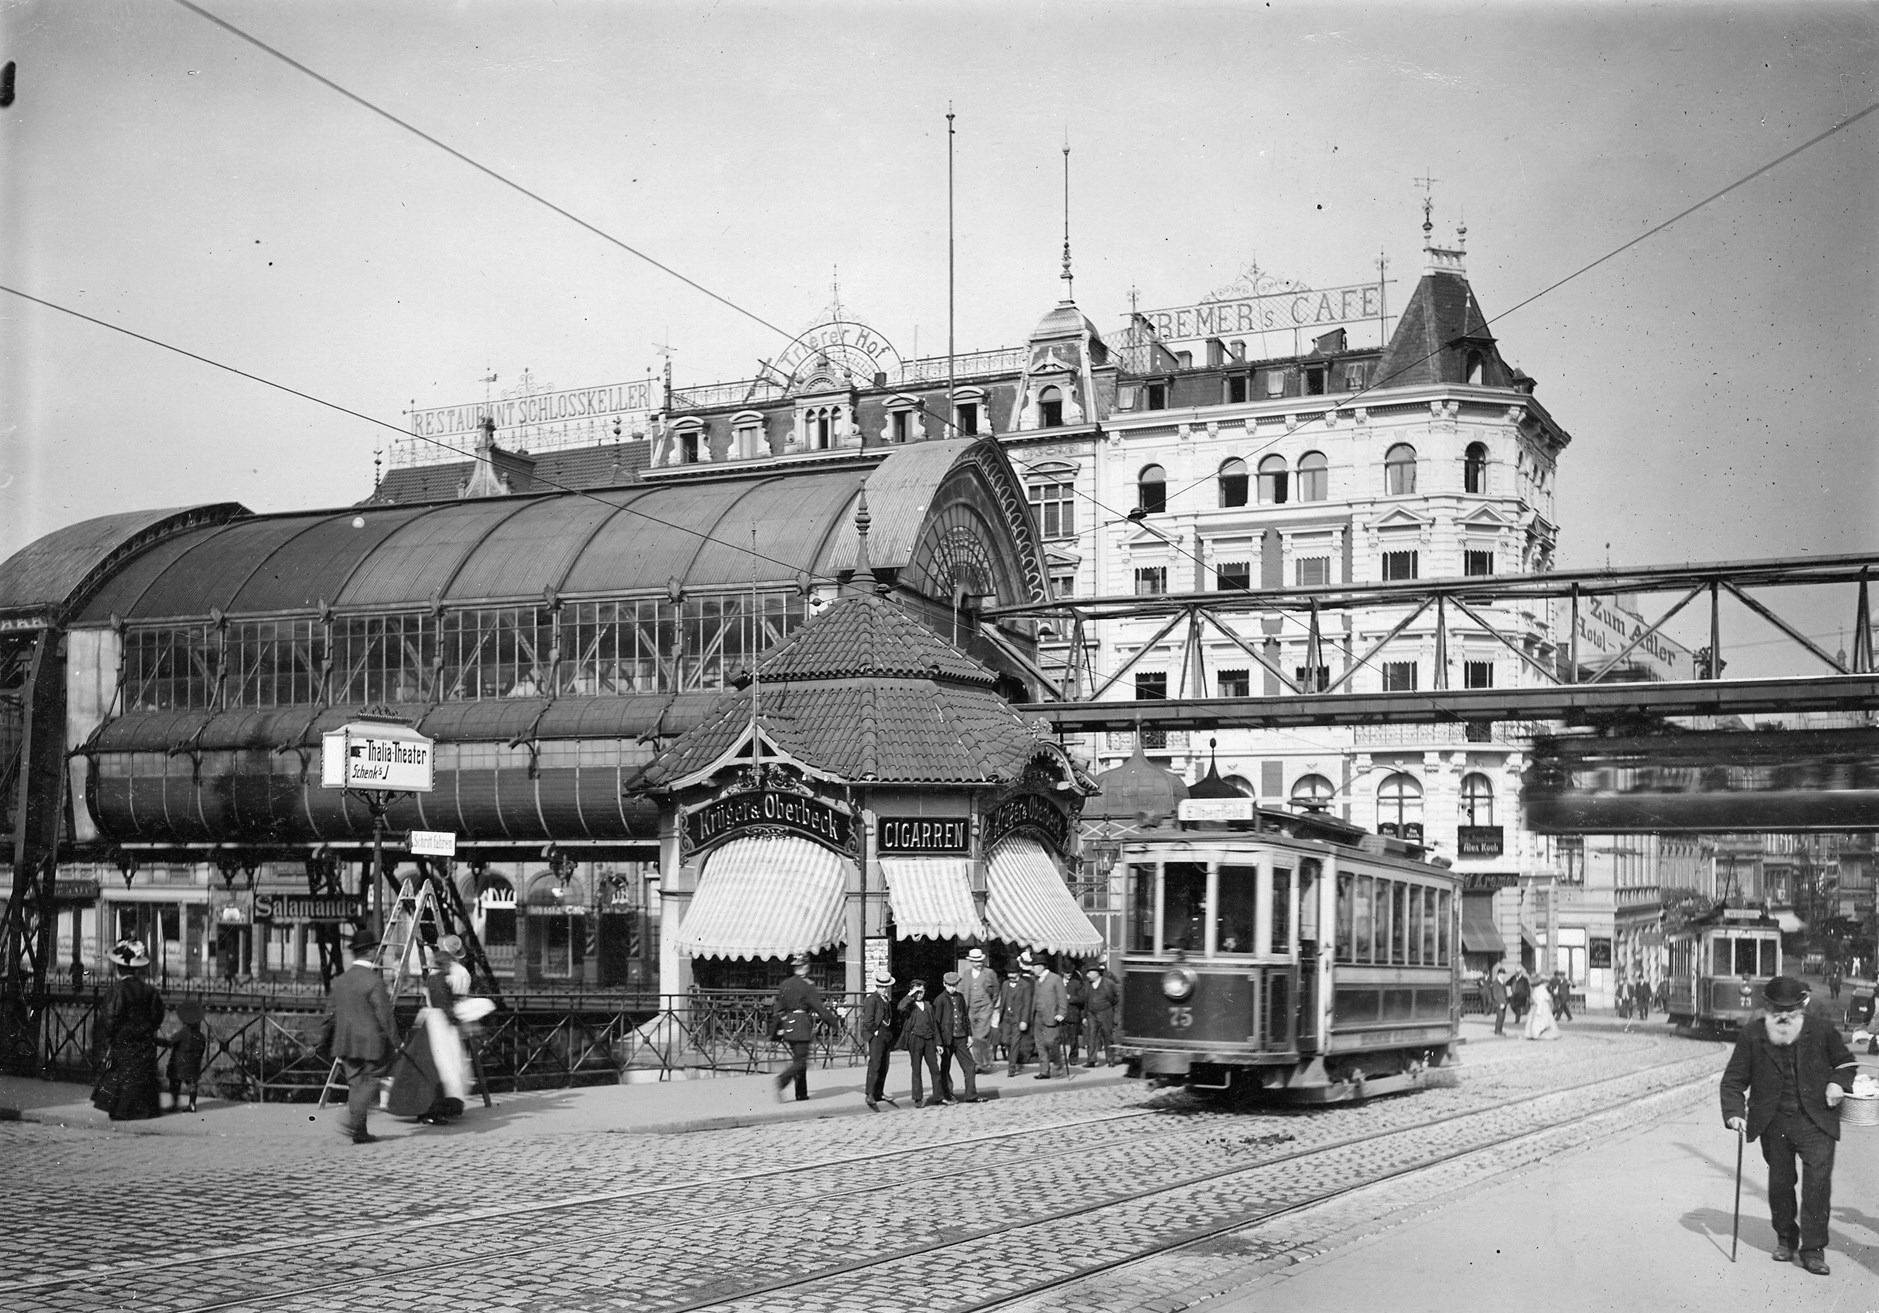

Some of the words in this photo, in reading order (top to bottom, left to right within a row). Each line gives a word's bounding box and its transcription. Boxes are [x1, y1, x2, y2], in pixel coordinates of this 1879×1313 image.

[1291, 287, 1379, 324] CAFE
[855, 329, 891, 359] Hof
[518, 384, 649, 424] SCHLOSSKELLER
[1590, 596, 1625, 637] Zum
[1629, 624, 1676, 667] Adler
[366, 739, 427, 765] Thalia-Theater
[699, 803, 749, 841] Krüger
[764, 793, 840, 841] Oberbeck
[884, 821, 965, 849] CIGARREN
[254, 894, 358, 918] Salamande
